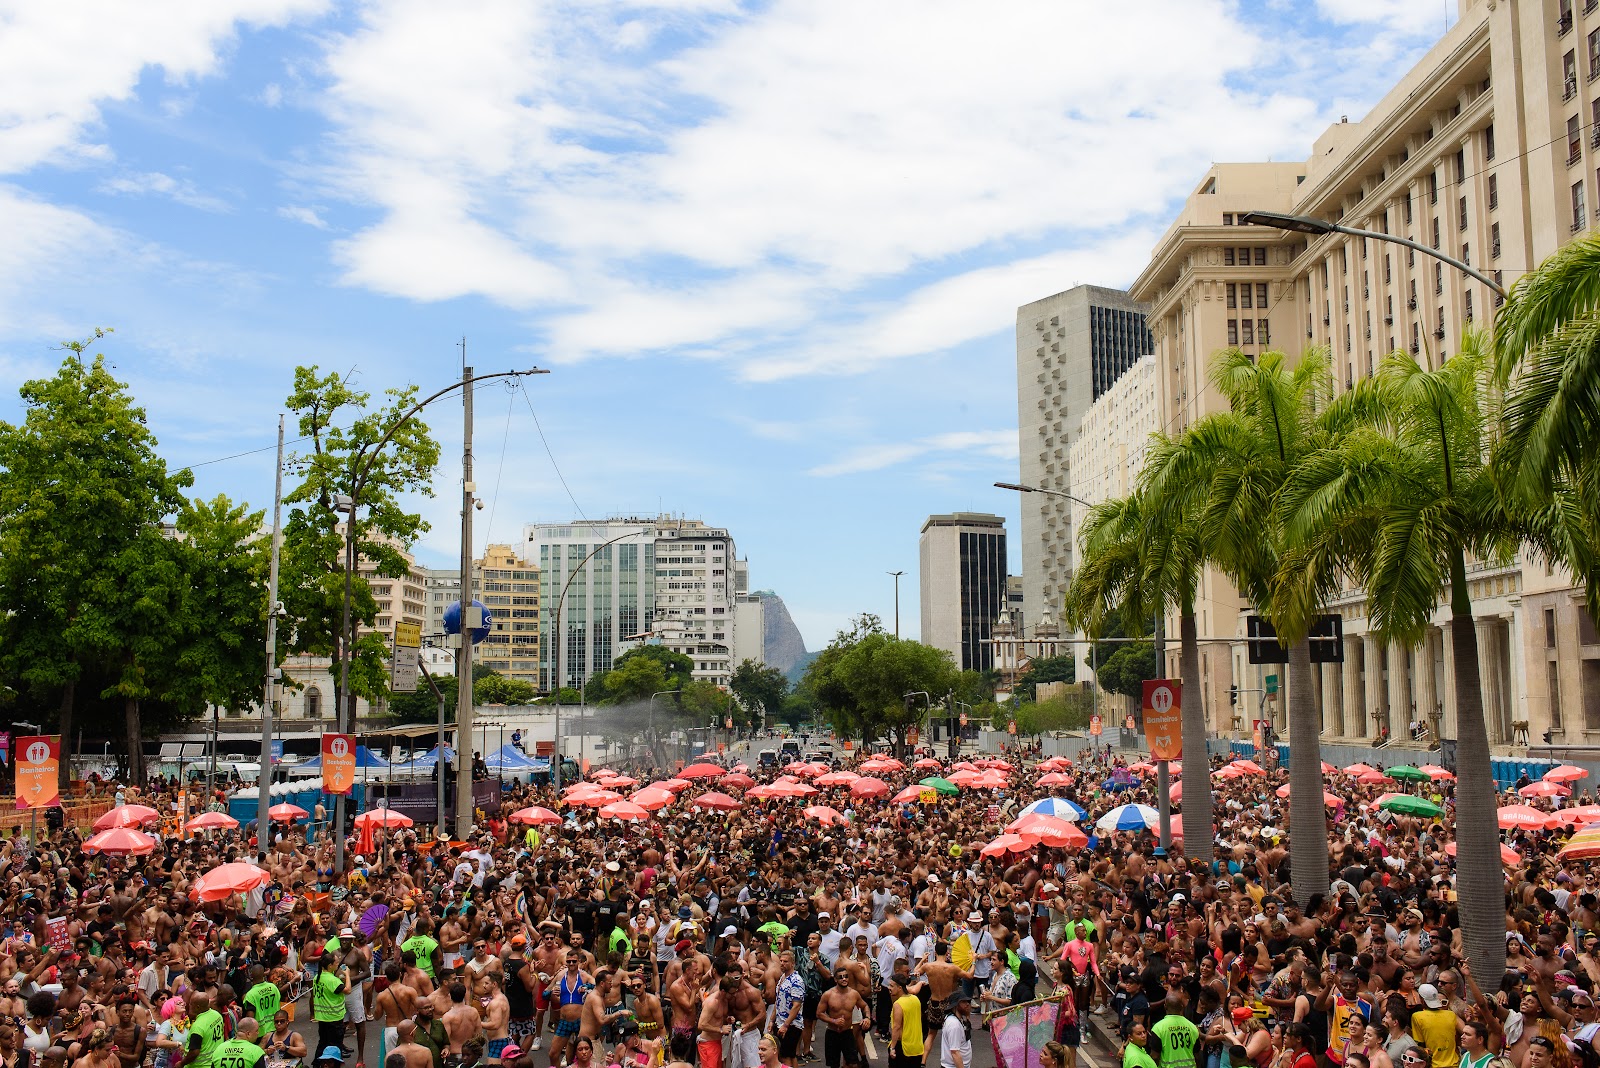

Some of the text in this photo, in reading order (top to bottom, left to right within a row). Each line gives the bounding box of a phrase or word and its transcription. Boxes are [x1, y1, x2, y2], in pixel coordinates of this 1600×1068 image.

[1146, 715, 1178, 724] Banheiros
[20, 766, 55, 774] Banheiros
[1503, 812, 1535, 823] BRAHMA
[1031, 825, 1062, 837] BRAHMA
[258, 986, 273, 995] UNIPAZ
[259, 993, 276, 1011] 607
[220, 1057, 245, 1068] 579
